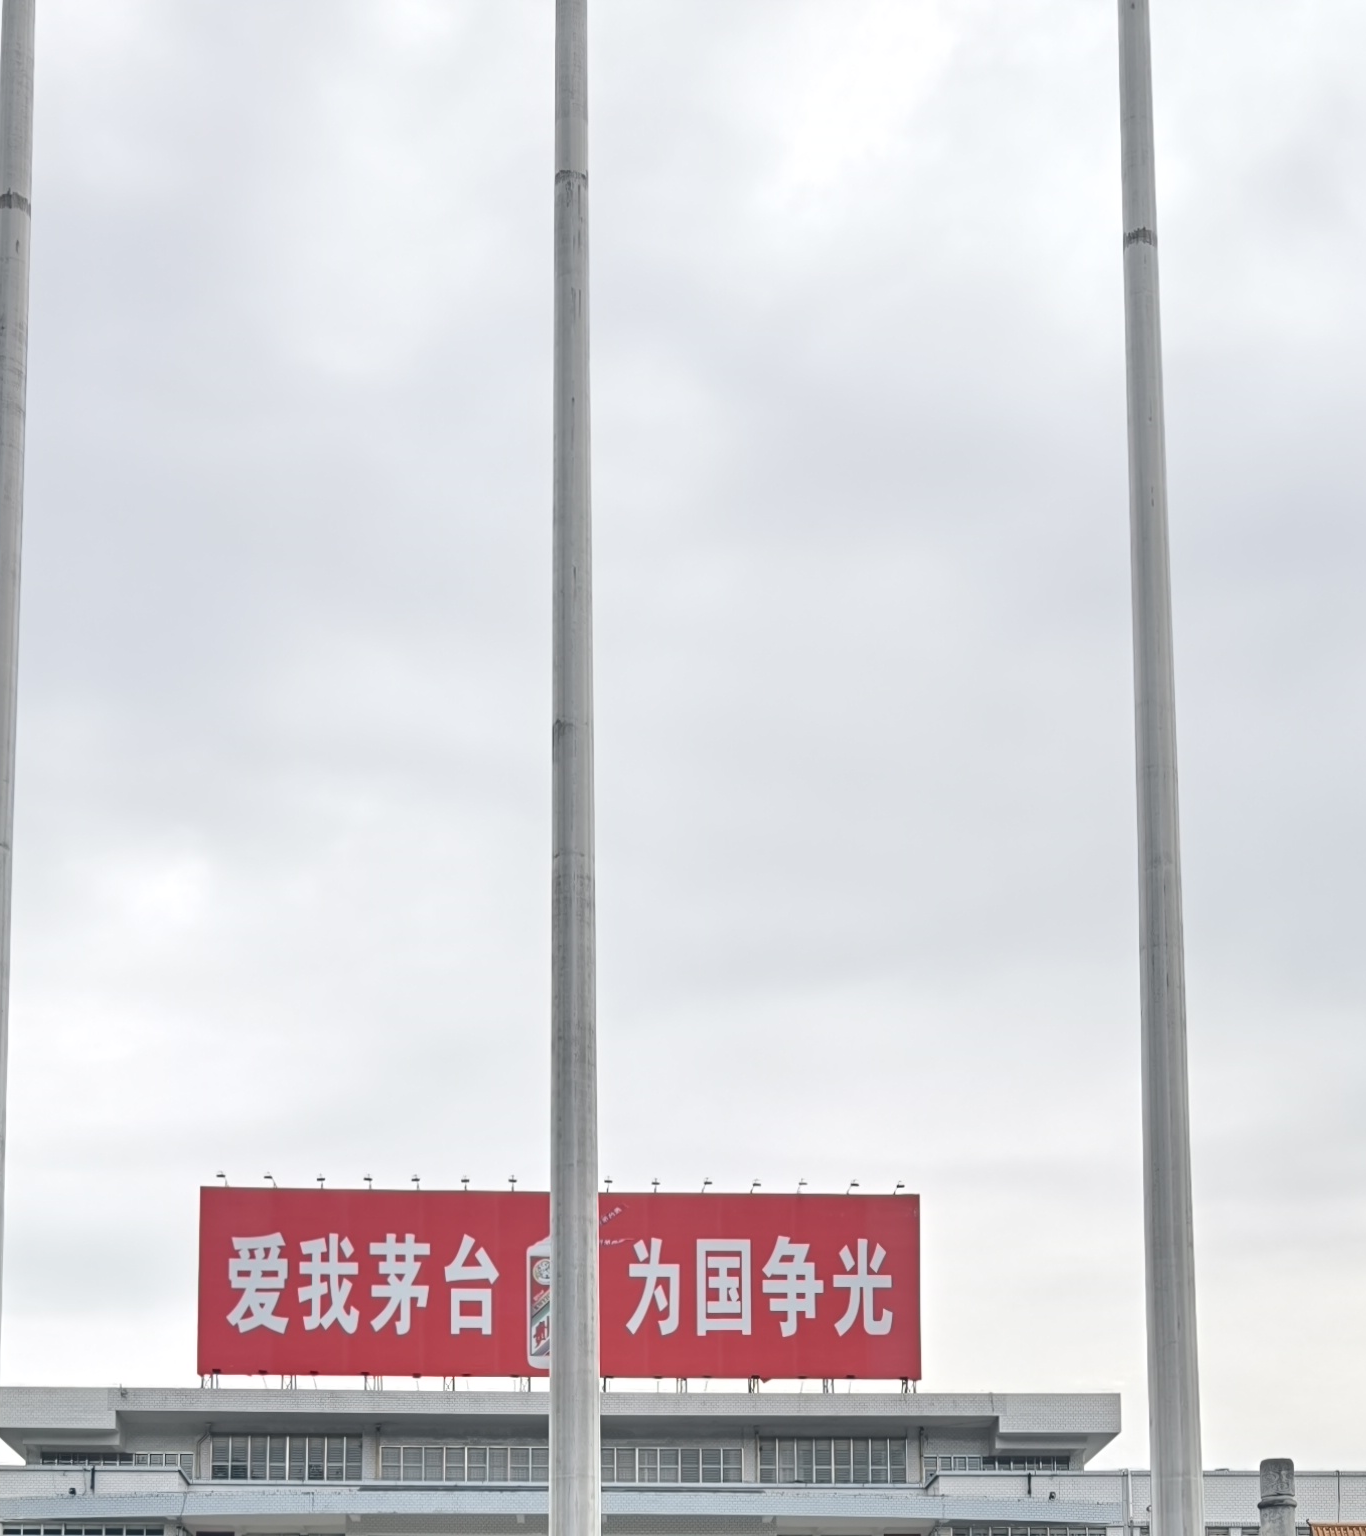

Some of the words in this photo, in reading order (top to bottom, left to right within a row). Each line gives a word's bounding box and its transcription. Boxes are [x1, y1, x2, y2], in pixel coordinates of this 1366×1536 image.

[226, 1232, 500, 1335] 爱我茅台
[625, 1235, 893, 1338] 为国争光
